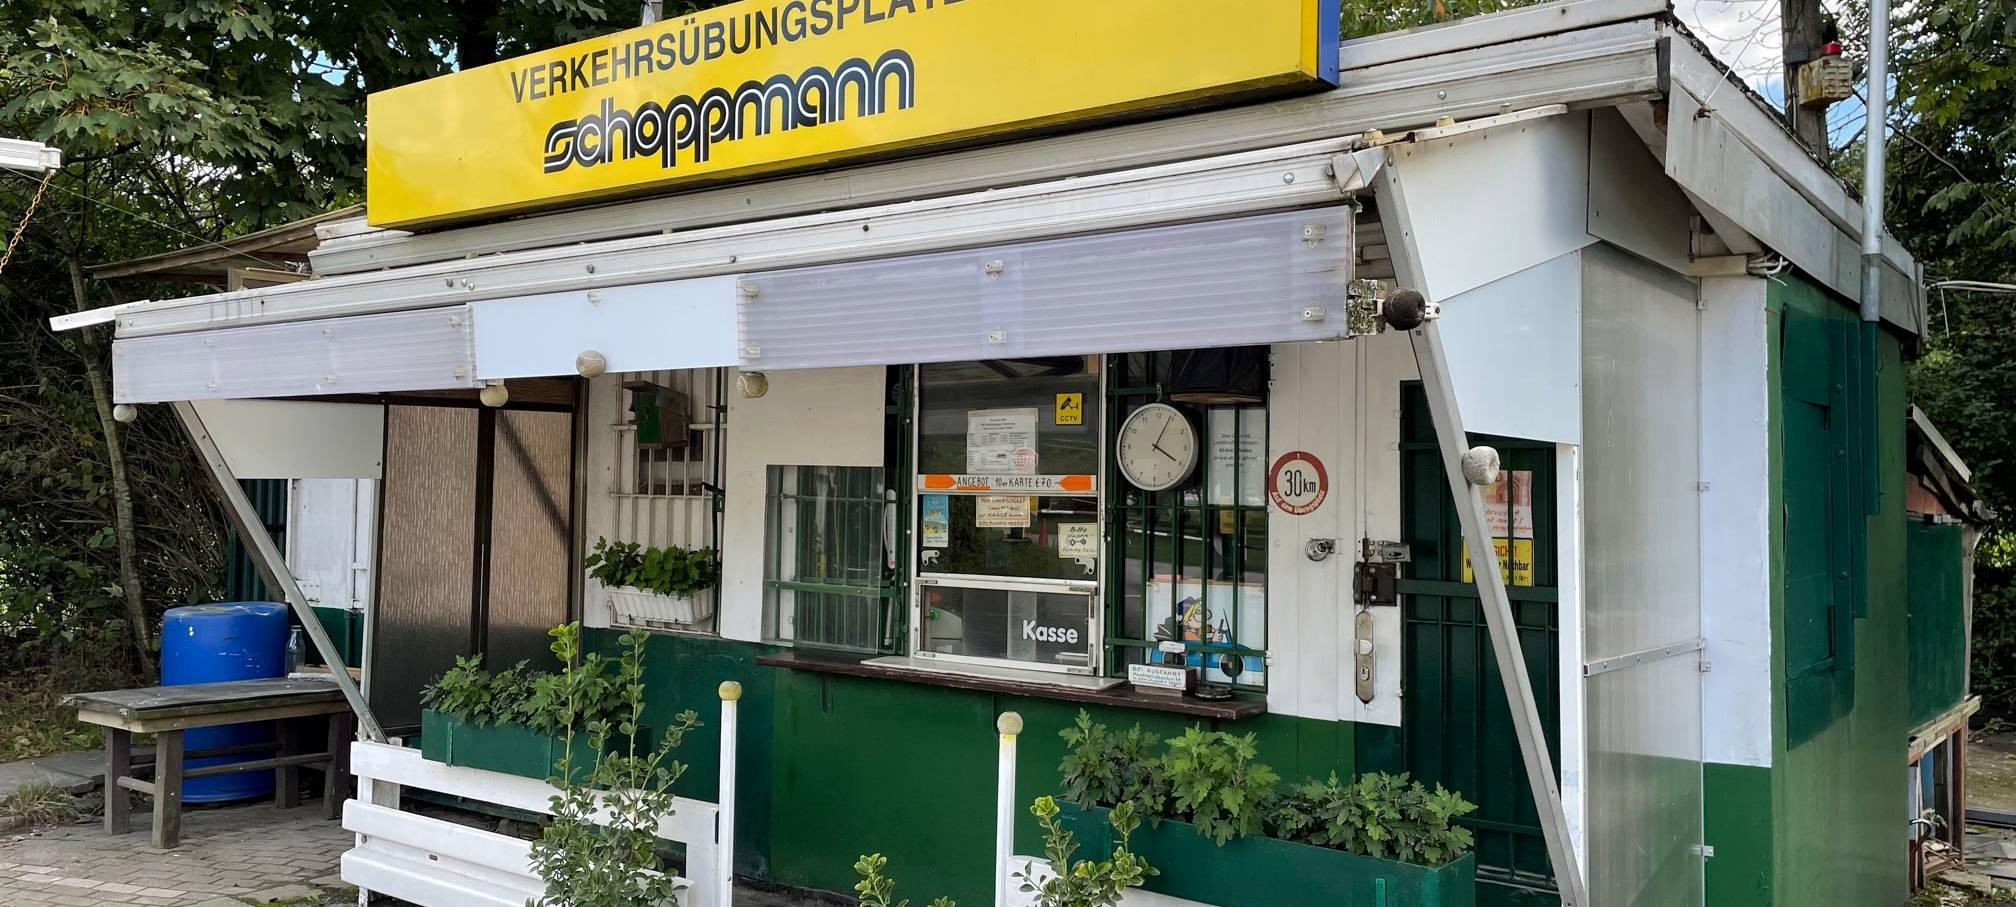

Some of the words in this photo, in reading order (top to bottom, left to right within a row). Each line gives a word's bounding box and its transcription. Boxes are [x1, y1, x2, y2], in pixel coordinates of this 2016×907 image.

[544, 49, 914, 174] schoppmann
[957, 476, 989, 486] ANGEBOT
[1009, 477, 1032, 488] KARTE
[1022, 619, 1079, 644] Kasse
